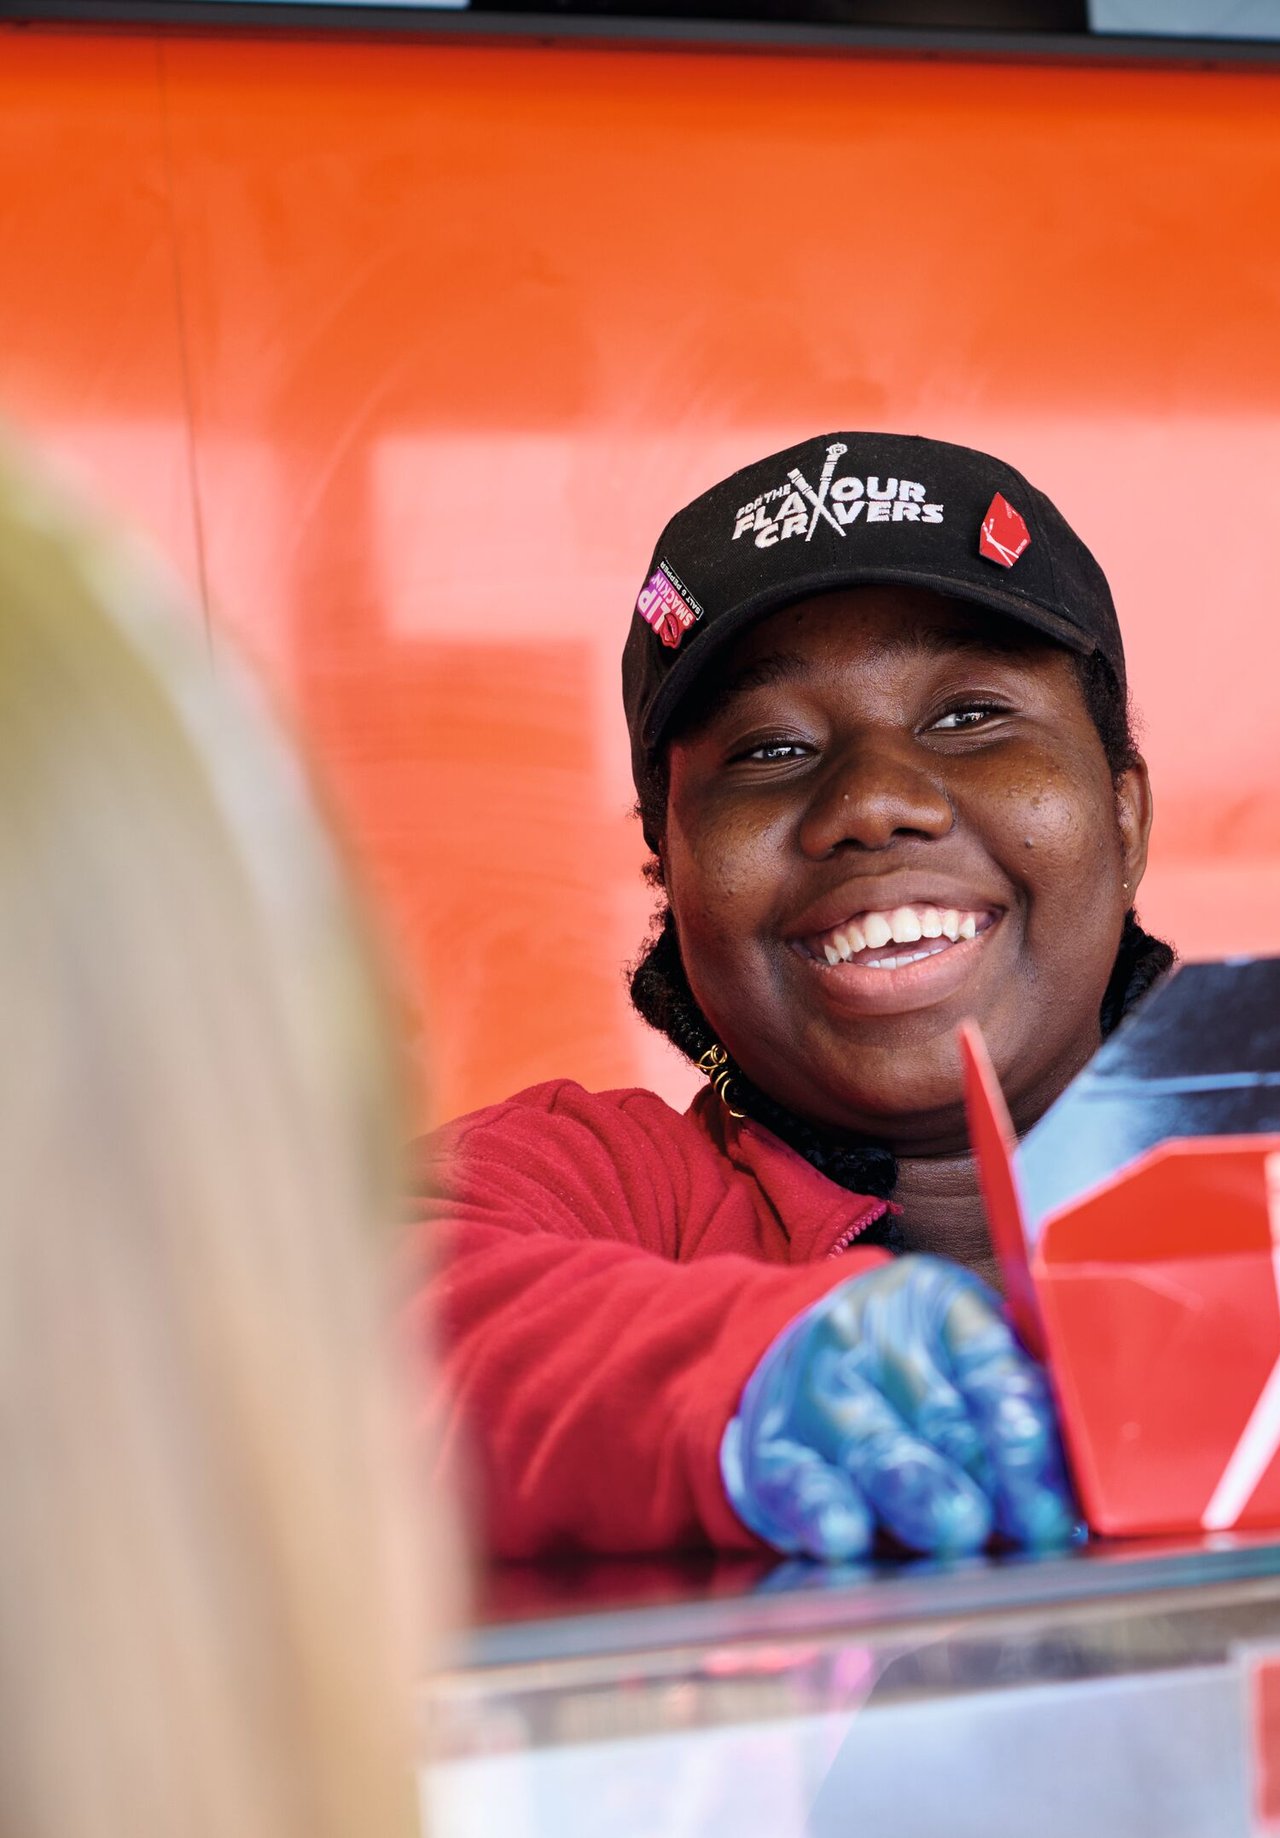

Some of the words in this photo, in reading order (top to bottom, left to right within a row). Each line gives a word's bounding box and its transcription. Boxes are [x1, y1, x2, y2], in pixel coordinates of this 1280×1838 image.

[735, 497, 762, 519] FOR
[763, 484, 791, 504] THE
[660, 560, 683, 591] PEPPER
[638, 589, 672, 631] LIP
[685, 596, 701, 615] SALT
